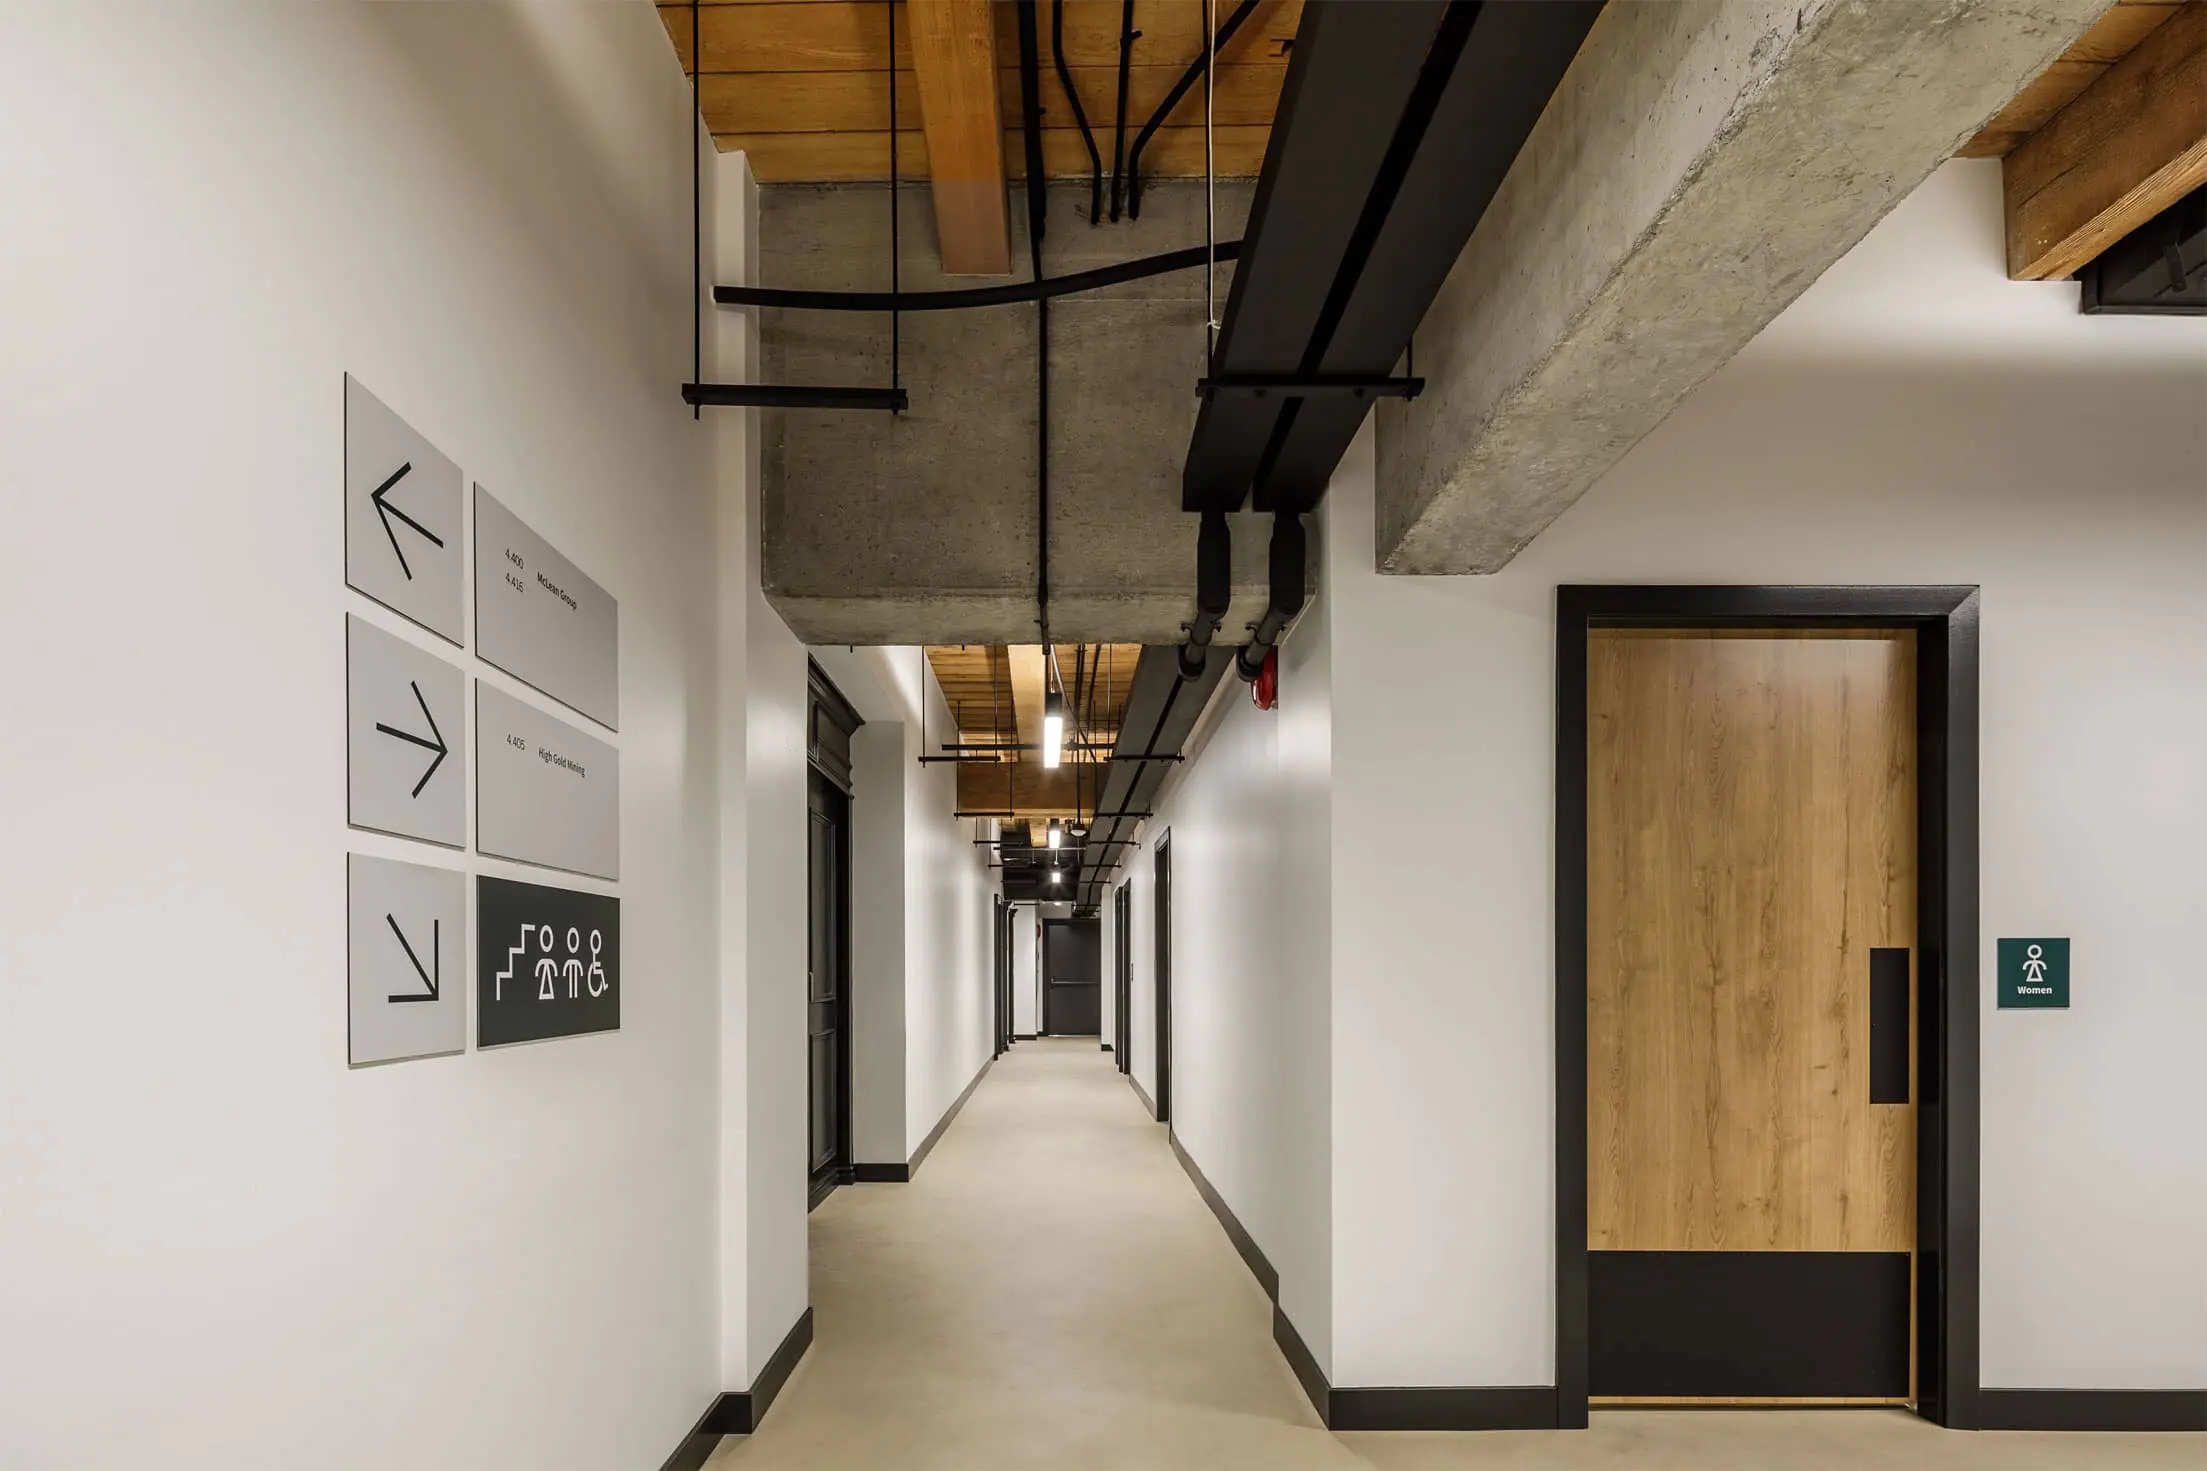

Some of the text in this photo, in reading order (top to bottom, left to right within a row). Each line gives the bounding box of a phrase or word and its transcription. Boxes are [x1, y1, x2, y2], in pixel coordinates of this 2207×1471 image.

[537, 571, 560, 597] McLean
[560, 589, 577, 611] Group
[538, 746, 553, 764] High
[553, 753, 567, 768] Gold
[567, 759, 586, 779] Mining
[2017, 986, 2053, 995] Women
